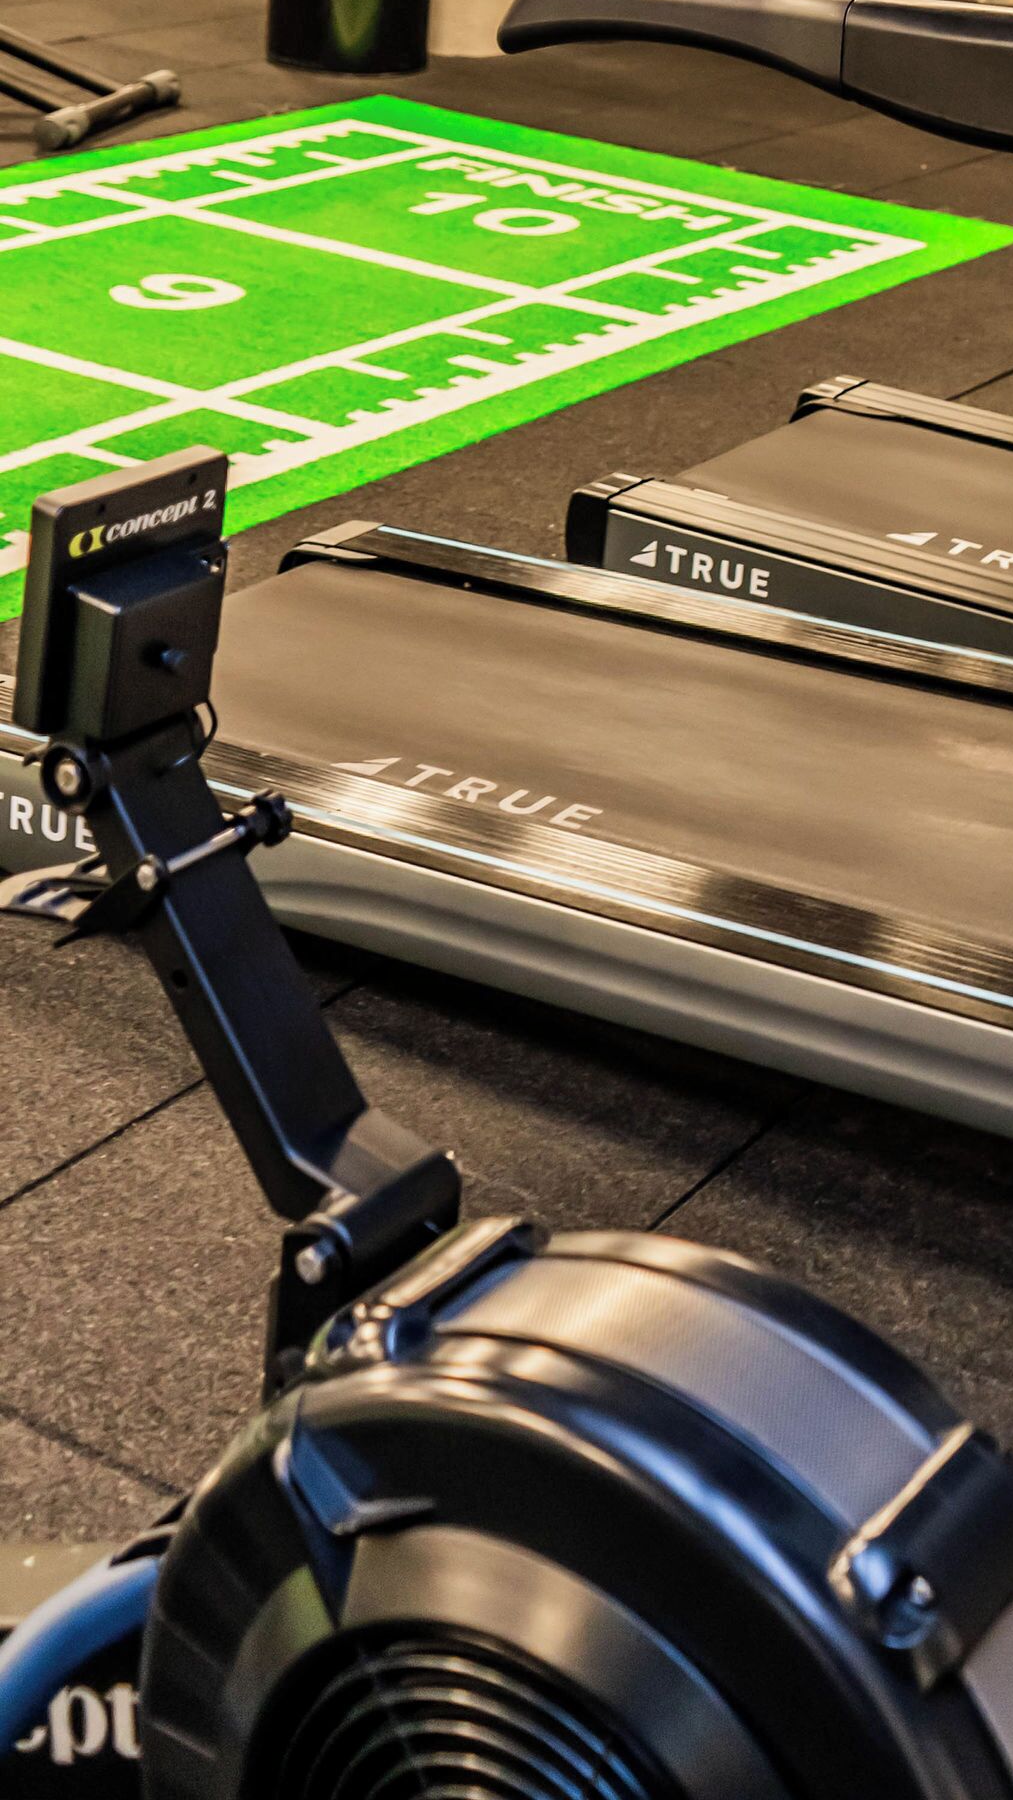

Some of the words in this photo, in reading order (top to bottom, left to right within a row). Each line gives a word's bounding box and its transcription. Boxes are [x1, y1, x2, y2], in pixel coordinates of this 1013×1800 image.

[408, 191, 581, 237] 10
[416, 156, 732, 231] FINISH
[105, 495, 199, 543] concept
[202, 489, 216, 509] 2
[664, 544, 771, 598] TRUE
[0, 792, 97, 853] RUE
[404, 763, 604, 830] TRUE
